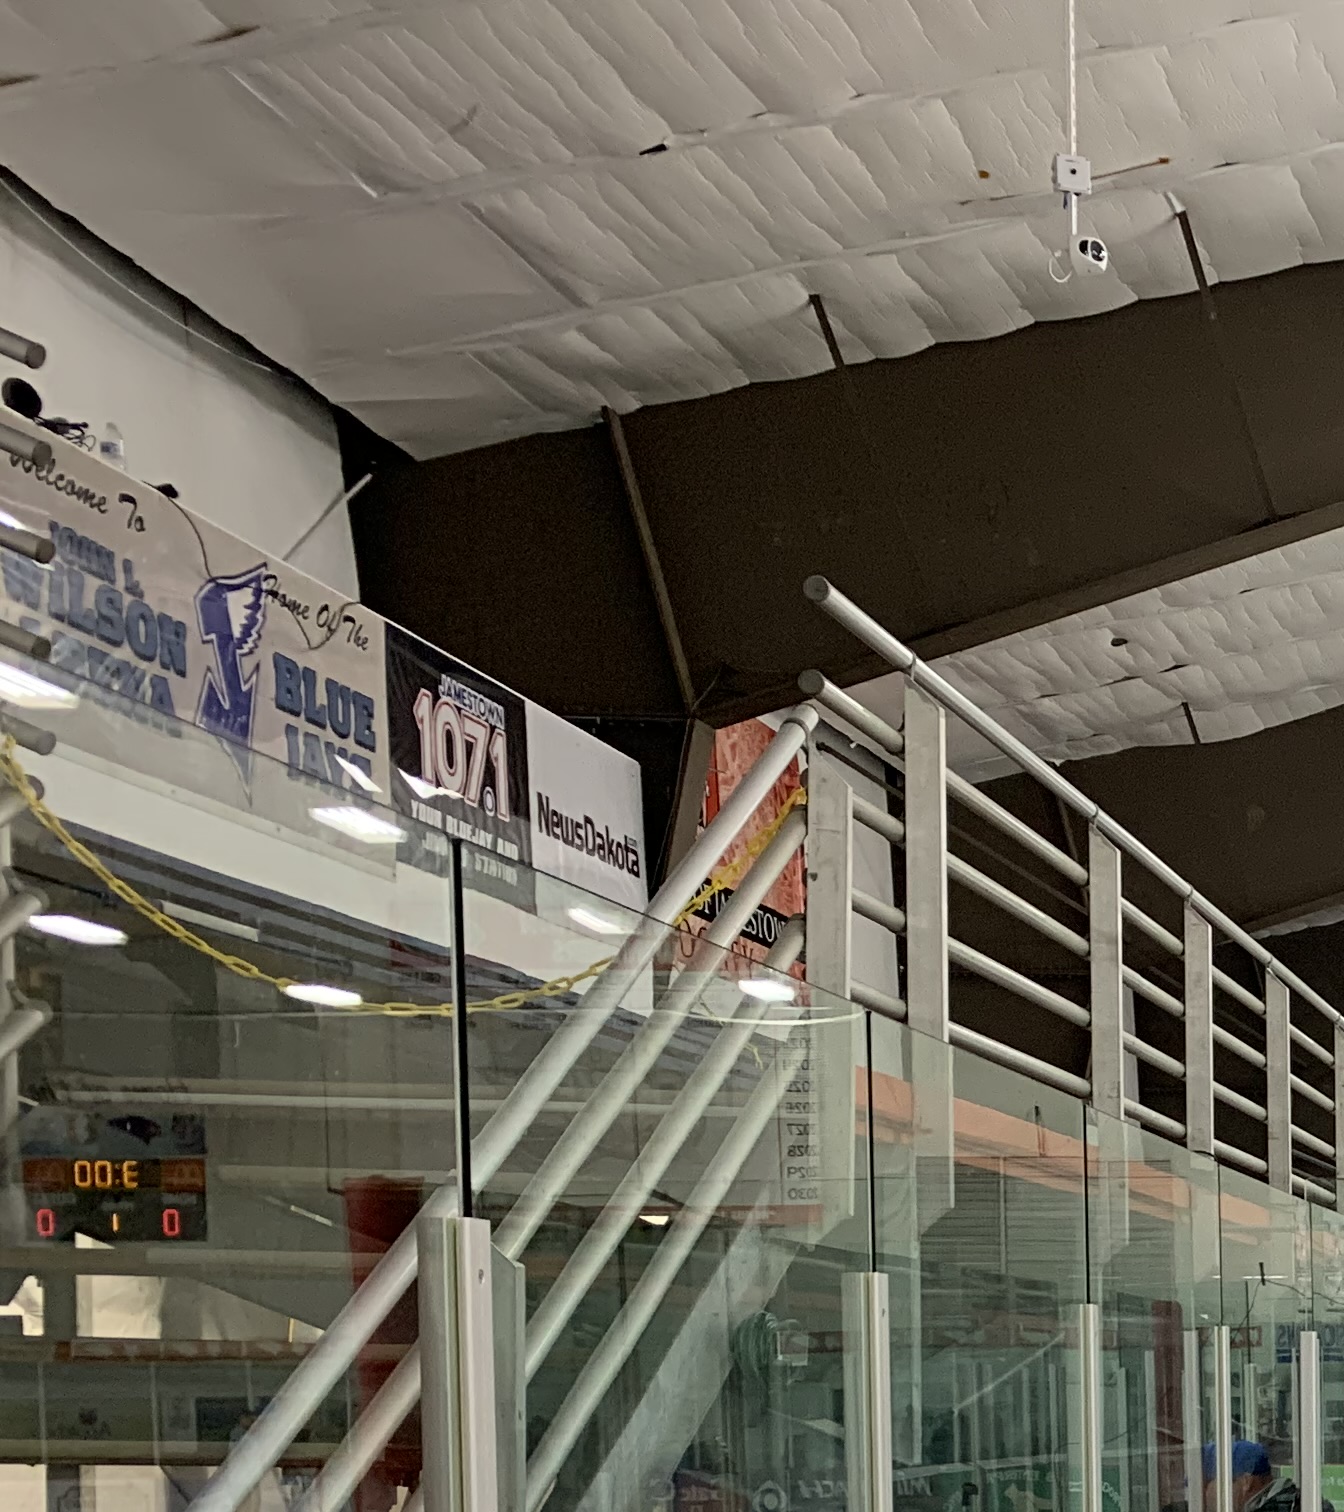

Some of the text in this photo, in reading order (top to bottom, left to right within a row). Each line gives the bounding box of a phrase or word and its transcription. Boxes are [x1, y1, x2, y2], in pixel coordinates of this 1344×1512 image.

[118, 493, 146, 533] To
[2, 552, 187, 678] WILSON
[262, 574, 310, 620] Home
[343, 614, 369, 652] The
[273, 651, 376, 753] BLUE
[438, 673, 505, 730] JAMESTOWN
[413, 688, 510, 822] 107.1
[411, 799, 442, 829] YOUR
[497, 841, 519, 861] AND
[536, 791, 641, 878] NewsDakota
